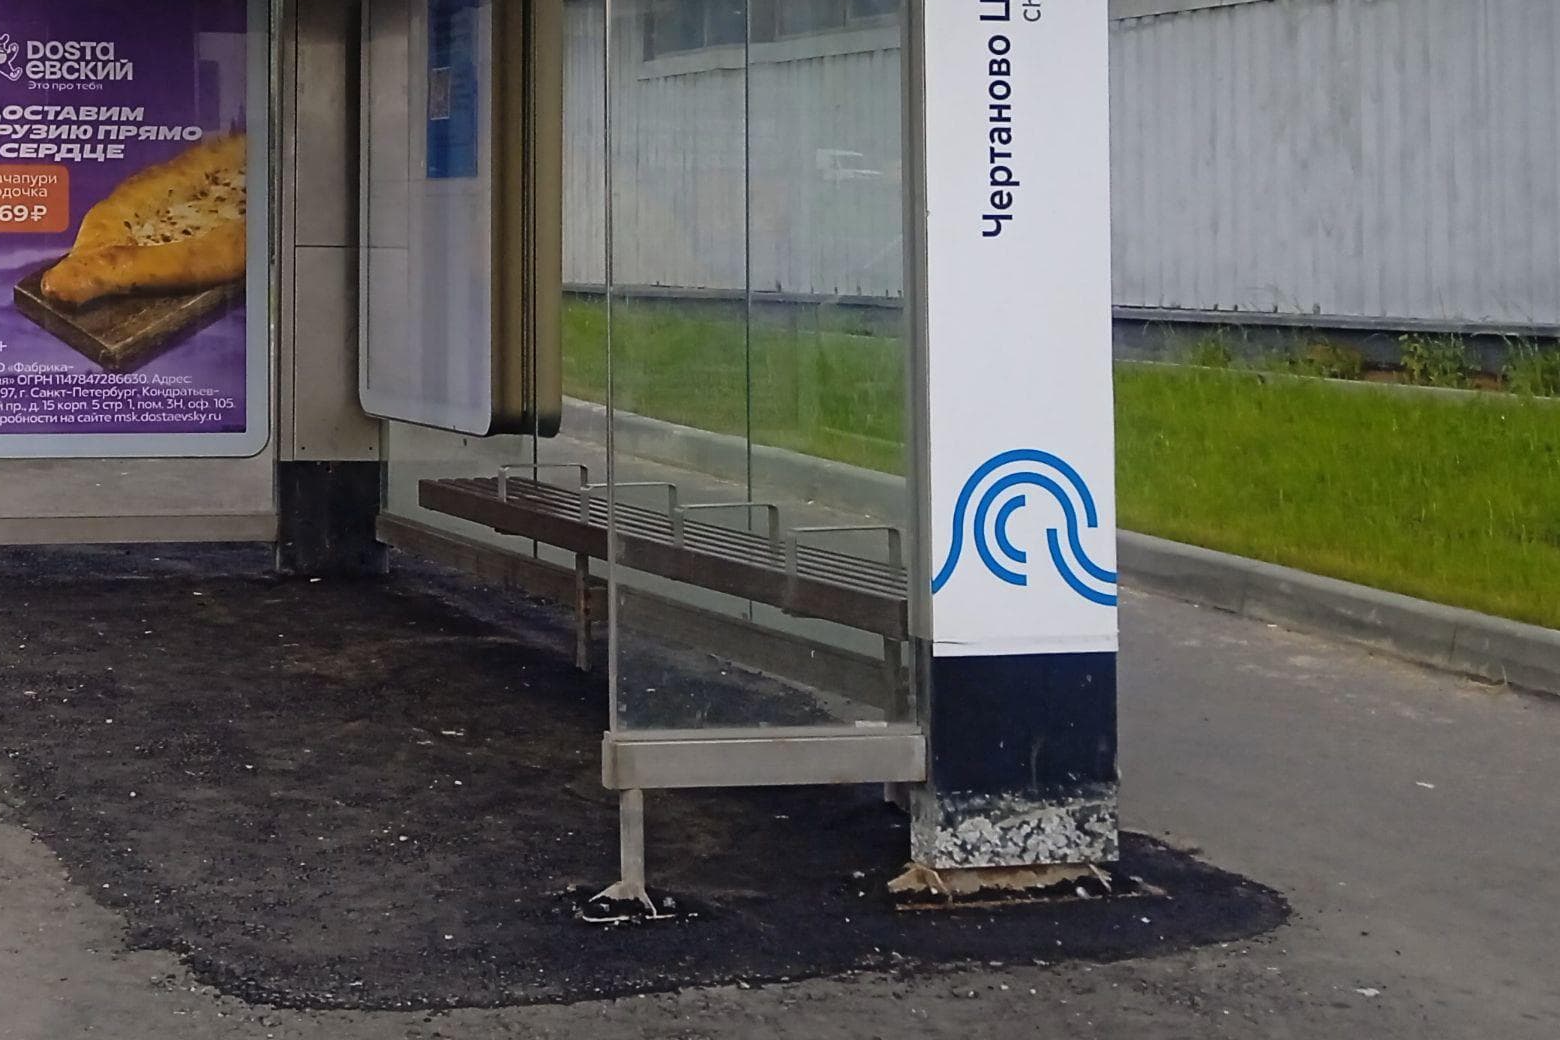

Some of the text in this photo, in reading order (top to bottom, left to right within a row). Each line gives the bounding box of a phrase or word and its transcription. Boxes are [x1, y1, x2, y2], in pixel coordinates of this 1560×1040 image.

[28, 81, 103, 92] Это про тебя
[97, 125, 202, 141] ПРЯМО
[982, 34, 1020, 238] Чертаново
[0, 142, 125, 162] СЕРДЦЕ
[17, 374, 53, 386] ОГРН
[152, 374, 192, 388] Адрес:
[142, 385, 220, 400] Кондратьев-
[42, 400, 55, 410] 15
[91, 400, 100, 410] 5
[137, 401, 164, 410] пом.
[60, 414, 74, 423] на
[77, 412, 112, 423] сайте
[114, 410, 222, 424] msk.dostaevsky.ru
